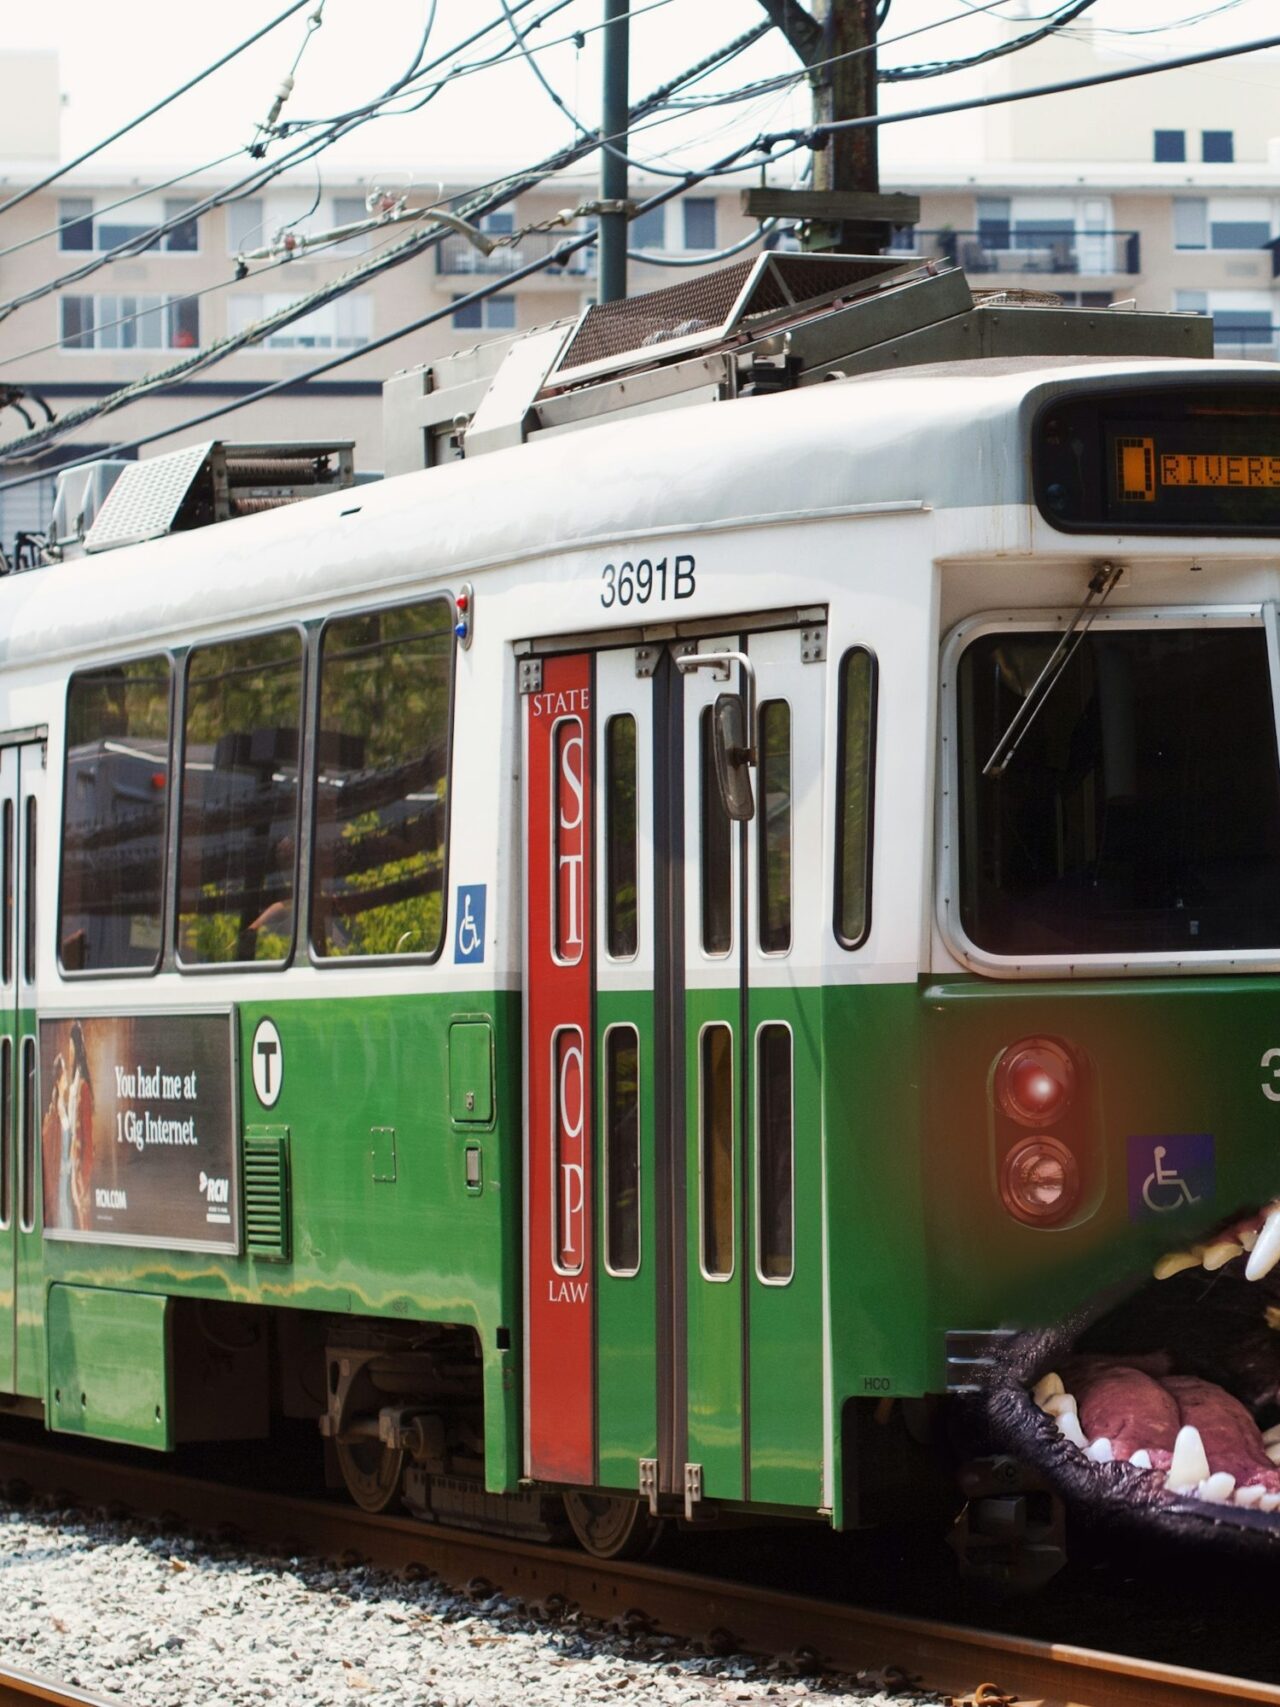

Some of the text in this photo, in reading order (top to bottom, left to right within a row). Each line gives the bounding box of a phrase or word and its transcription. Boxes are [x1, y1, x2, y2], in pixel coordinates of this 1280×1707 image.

[600, 554, 696, 609] 3691B
[532, 687, 589, 717] STATE
[115, 1065, 197, 1099] You had me at
[257, 1042, 278, 1094] T
[116, 1110, 198, 1151] 1 Gig Internet.
[549, 1280, 589, 1303] LAW
